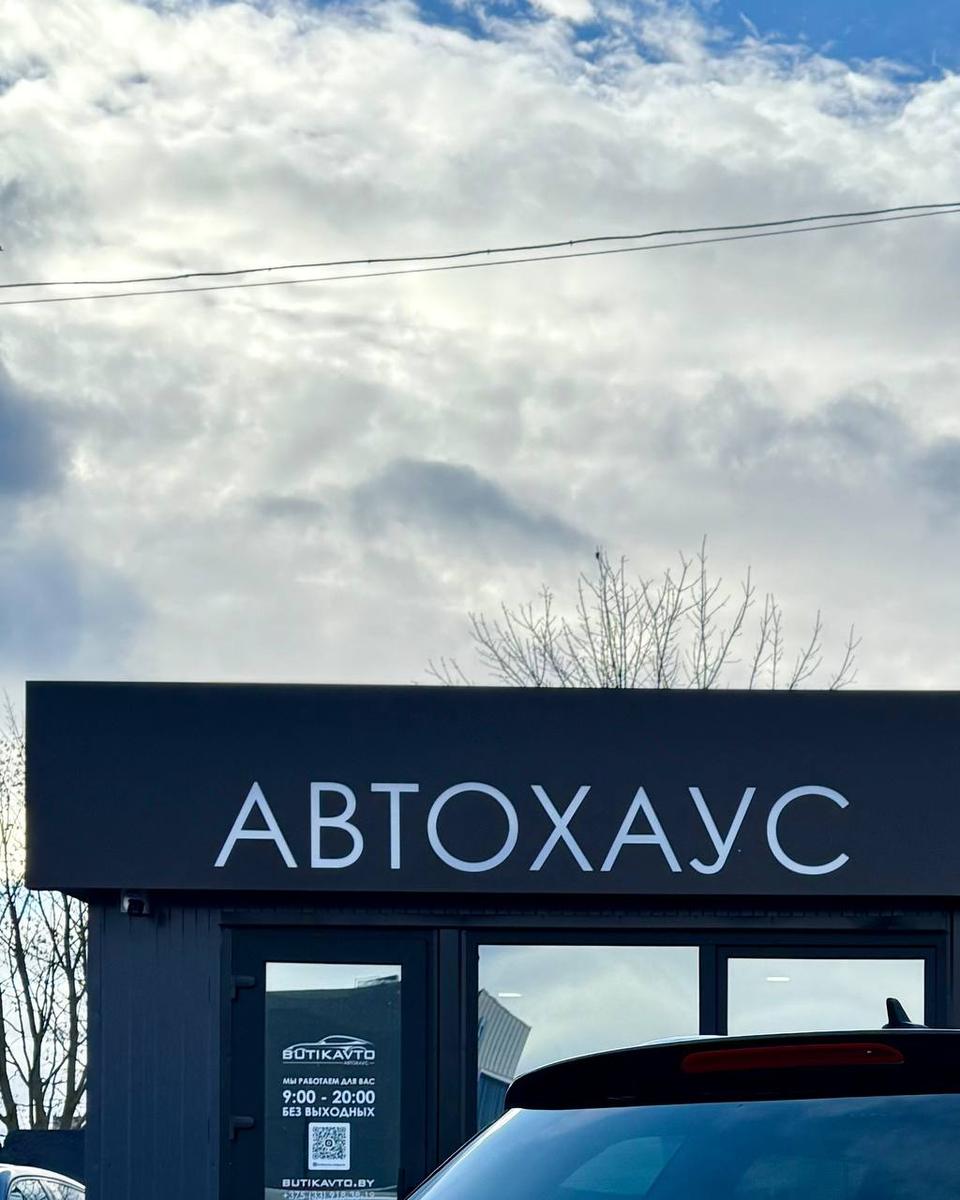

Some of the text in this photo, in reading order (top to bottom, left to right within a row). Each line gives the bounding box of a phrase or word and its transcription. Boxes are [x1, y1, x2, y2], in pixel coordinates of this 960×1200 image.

[213, 780, 852, 876] АВТОХАУС
[282, 1049, 376, 1061] BUTIKAVTO
[340, 1078, 357, 1086] ДЛЯ
[282, 1090, 316, 1104] 9:00
[332, 1090, 376, 1104] 20:00
[282, 1107, 375, 1118] БЕЗ ВЫХОДНЫХ
[282, 1179, 375, 1188] BUTIKAVTO.BY
